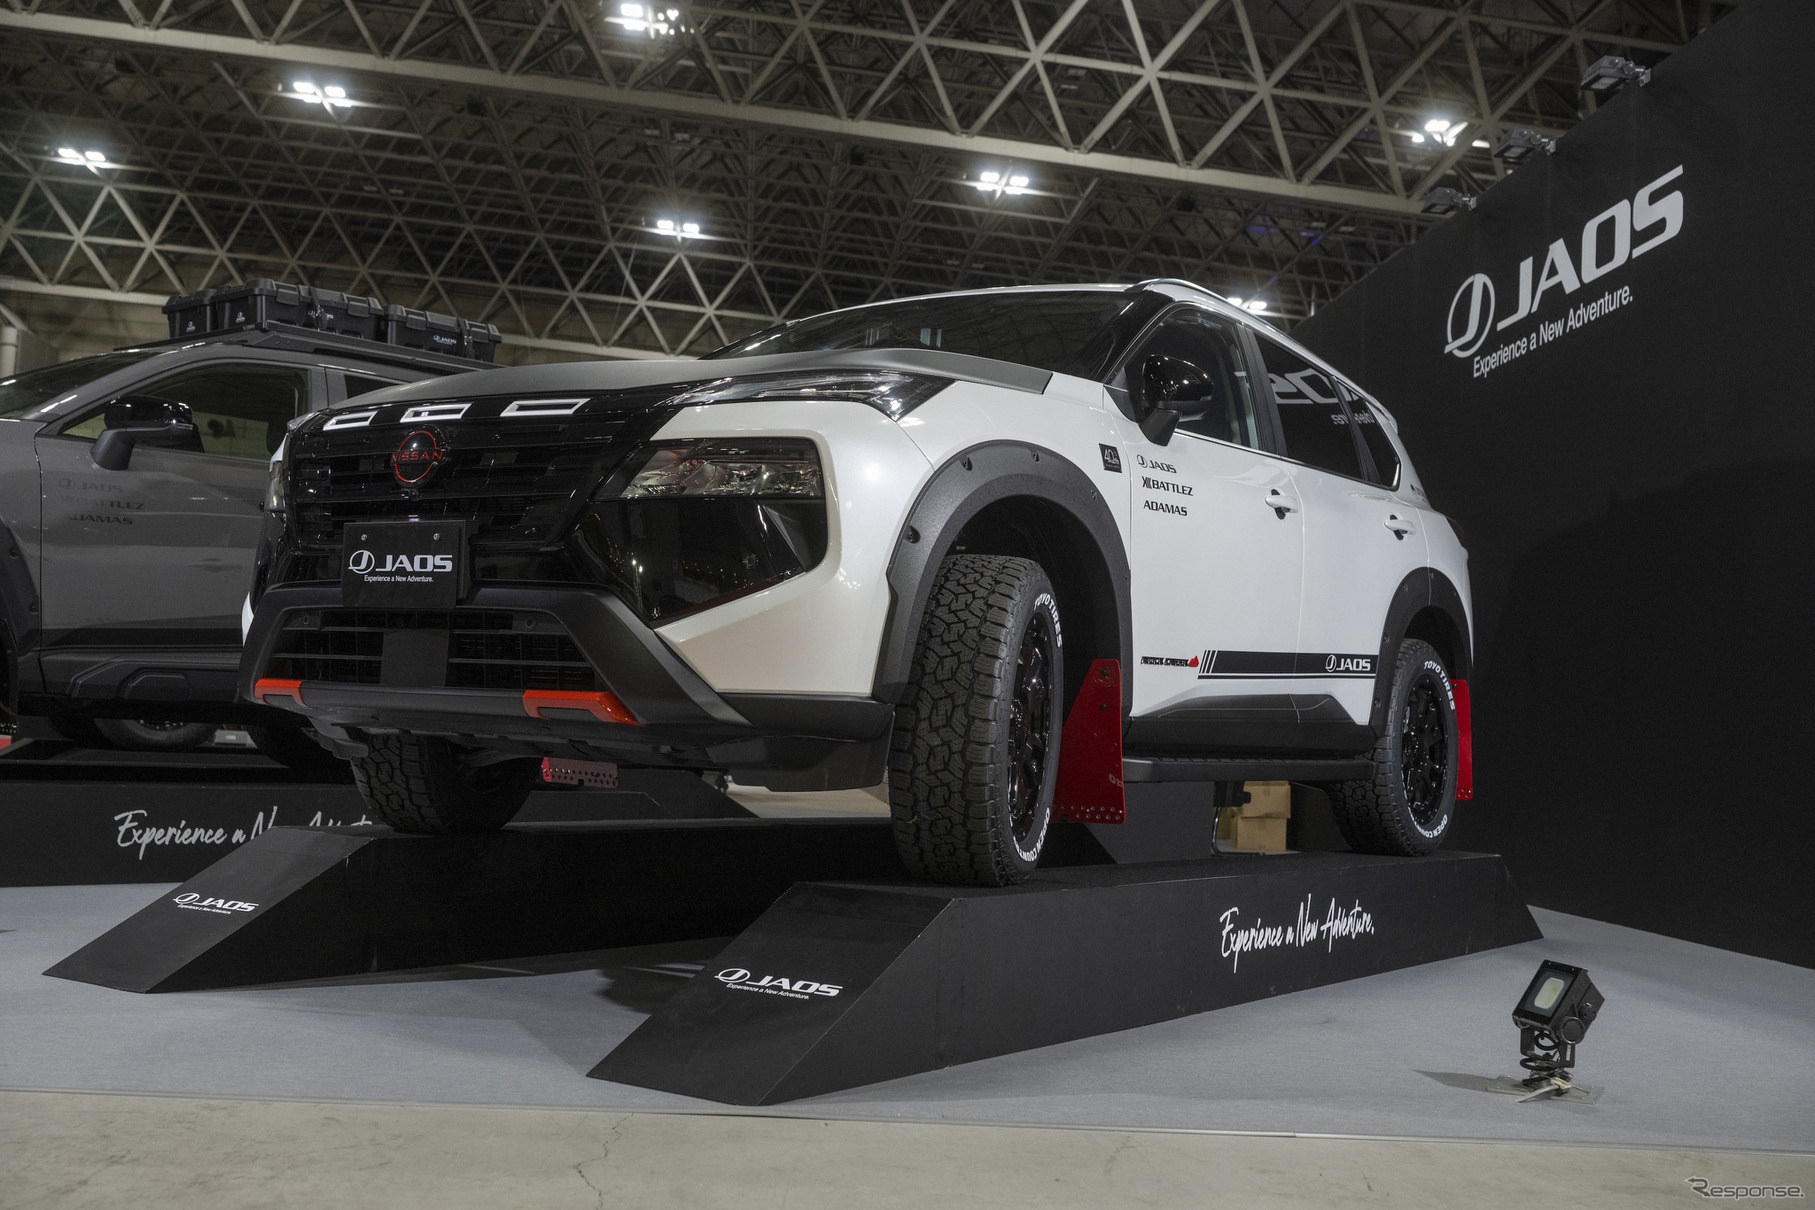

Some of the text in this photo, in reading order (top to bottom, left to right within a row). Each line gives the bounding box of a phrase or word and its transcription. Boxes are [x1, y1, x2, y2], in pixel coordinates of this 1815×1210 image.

[1497, 164, 1684, 332] JAOS
[1473, 285, 1633, 378] Experience a New Adventure.
[392, 451, 443, 463] NISSAN
[1149, 460, 1177, 474] JAOS
[1143, 500, 1188, 517] ADAMAS
[375, 554, 453, 572] JAOS
[364, 574, 391, 583] Experience
[395, 574, 406, 582] New
[407, 574, 434, 582] Adventure.
[1336, 658, 1371, 672] JAOS
[1424, 660, 1441, 674] TOYO
[114, 809, 227, 860] Experience
[232, 825, 247, 845] a
[193, 897, 259, 912] JAOS
[1219, 893, 1375, 974] Experience a New Adventure.
[726, 982, 759, 992] Experience
[764, 987, 777, 995] New
[777, 989, 810, 1000] Adventure.
[745, 975, 843, 997] JAOS
